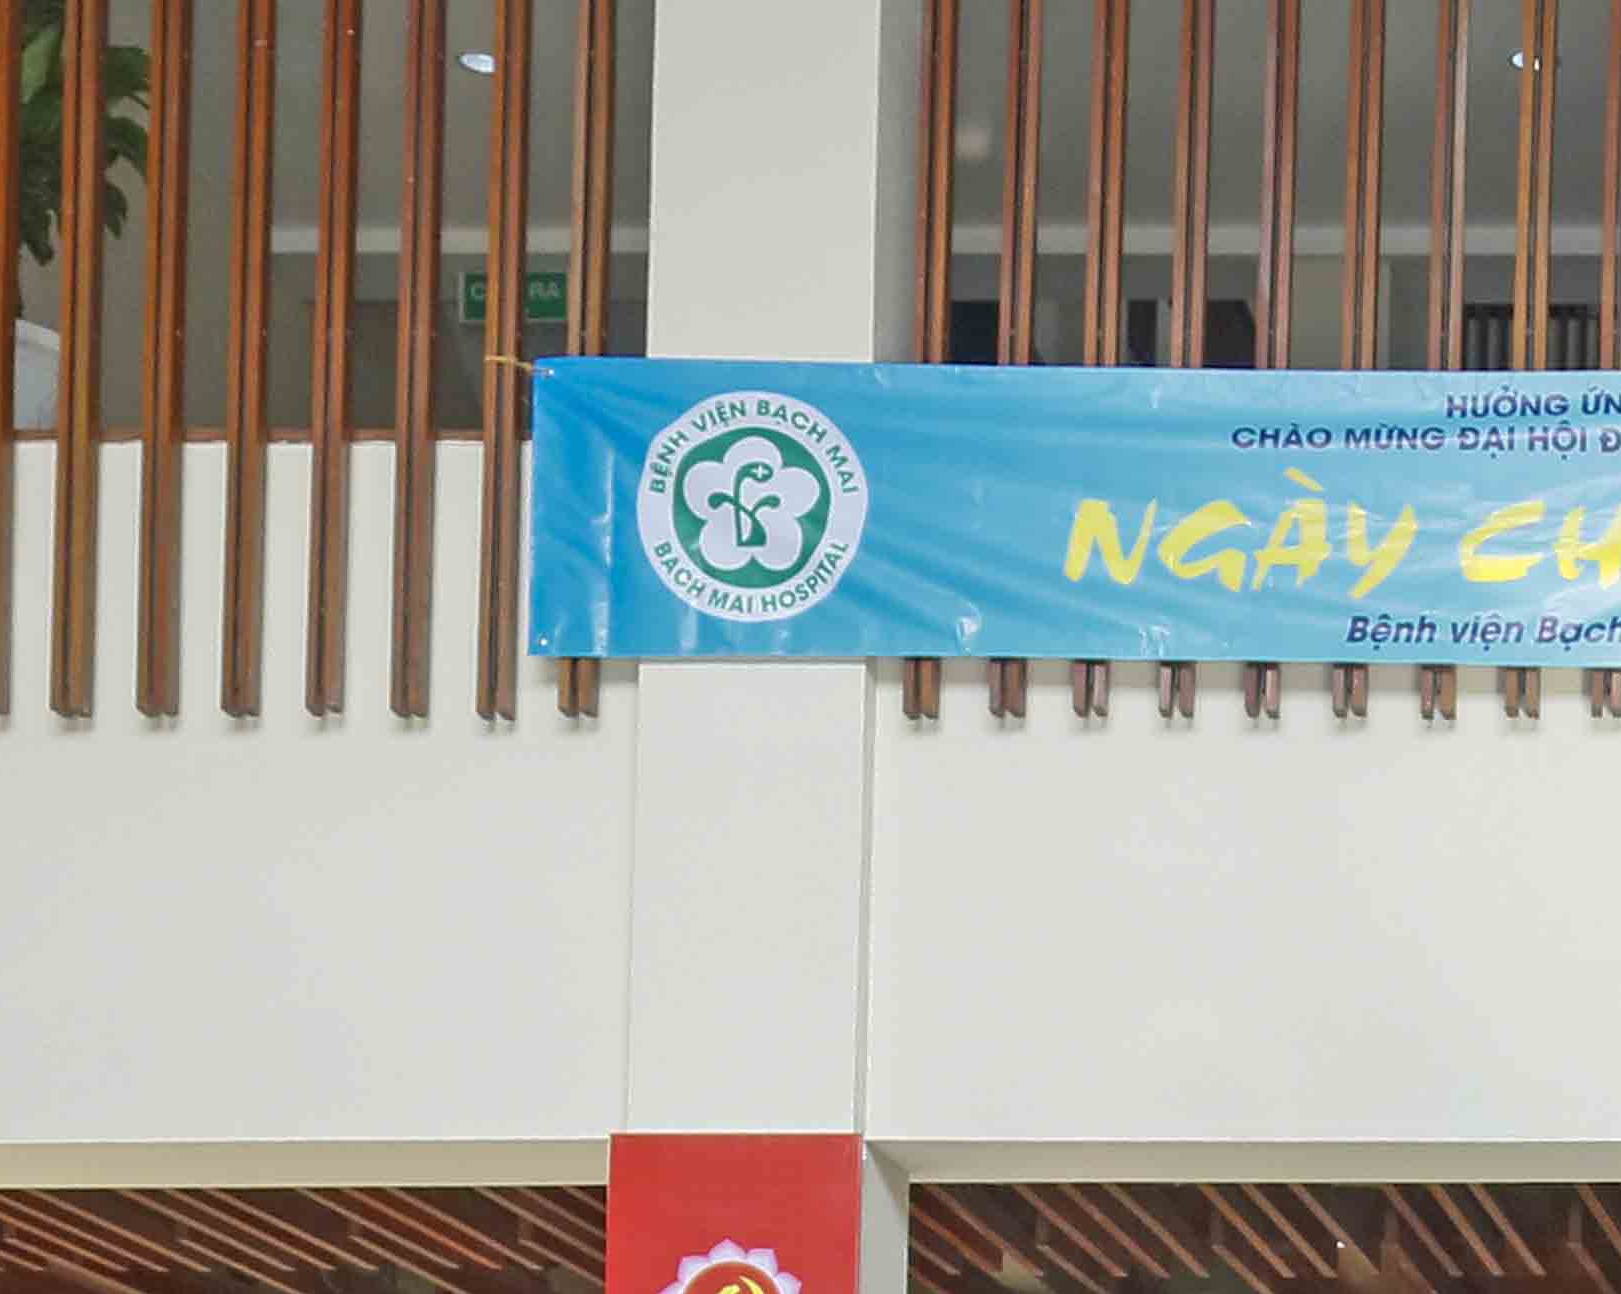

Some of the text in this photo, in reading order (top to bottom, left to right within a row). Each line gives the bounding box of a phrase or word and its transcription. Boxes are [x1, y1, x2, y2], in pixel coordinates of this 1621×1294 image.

[649, 399, 859, 494] BỆNH VIỆN BẠCH MAI
[1232, 421, 1332, 450] CHÀO
[1344, 421, 1446, 451] MỪNG
[1455, 424, 1517, 460] ĐẠI
[1527, 421, 1588, 461] HỘI
[1063, 467, 1418, 600] NGÀY
[654, 541, 850, 614] BACH MAI HOSPITAL
[1345, 616, 1438, 645] Bệnh
[1450, 616, 1526, 646] viện
